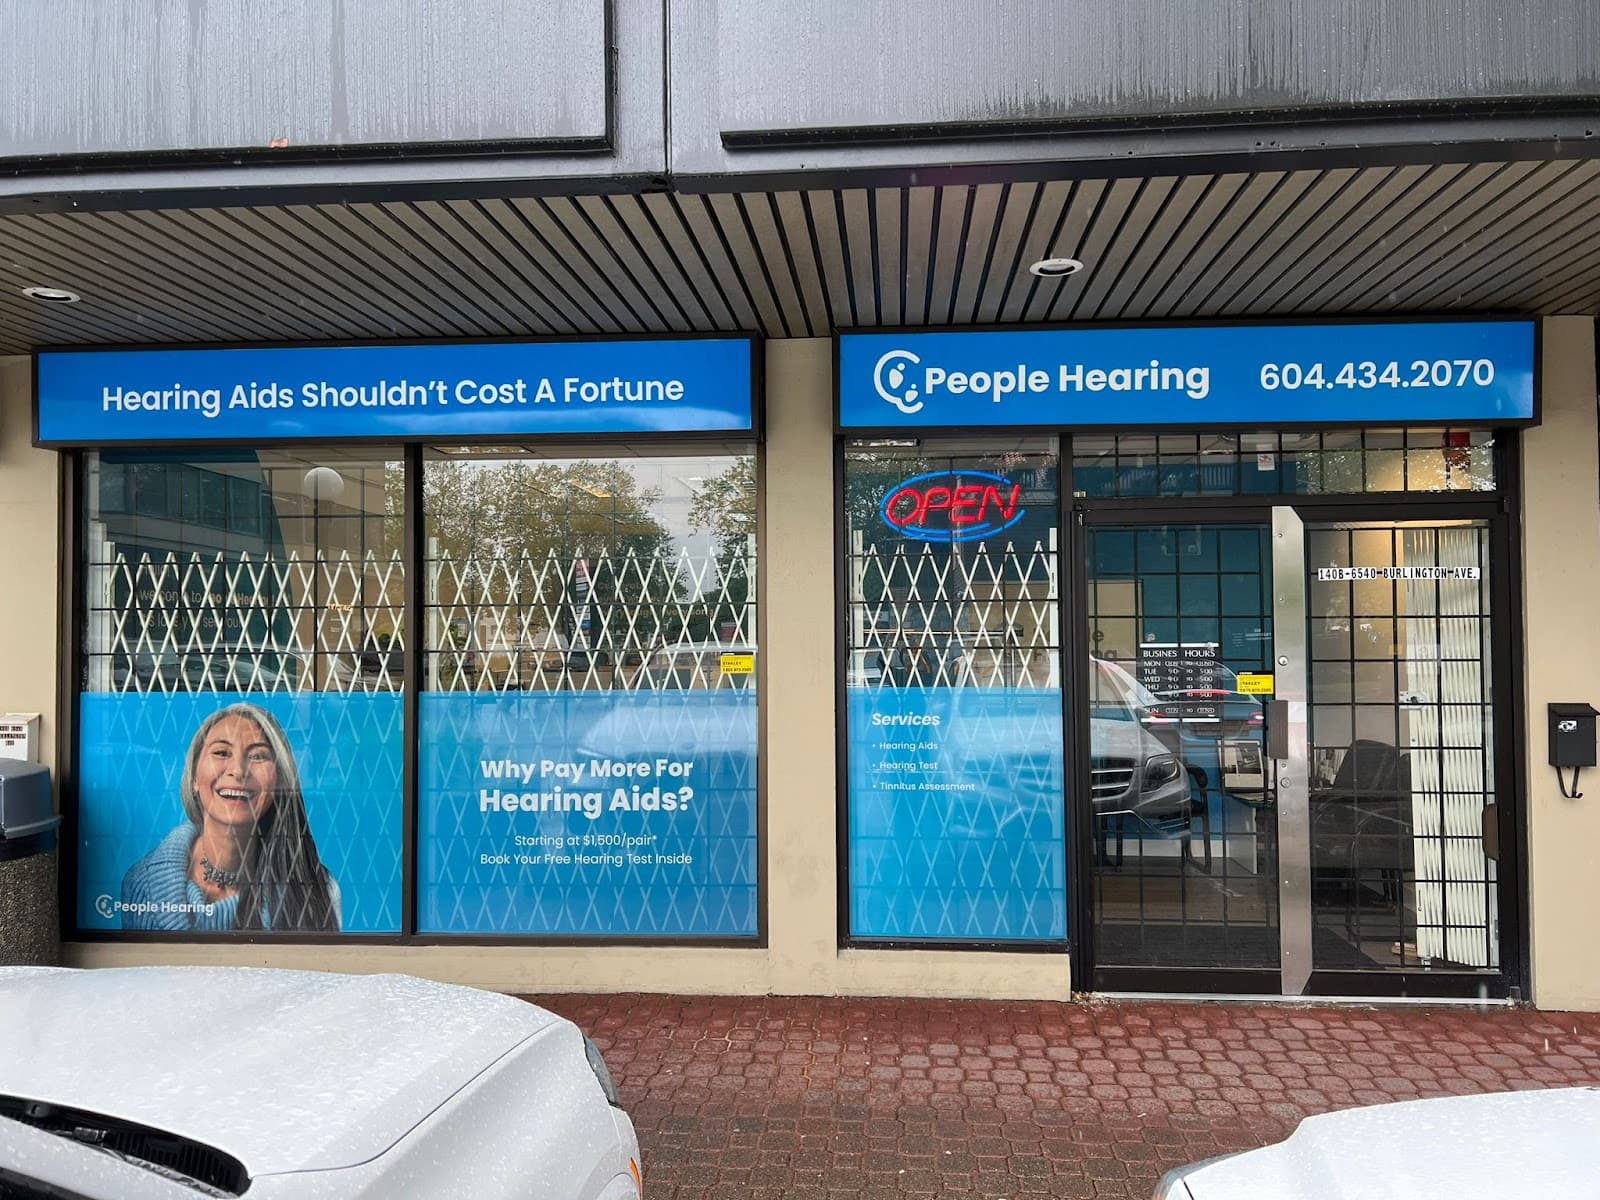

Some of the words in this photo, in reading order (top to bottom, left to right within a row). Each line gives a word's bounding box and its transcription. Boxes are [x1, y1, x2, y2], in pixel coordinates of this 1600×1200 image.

[925, 364, 1050, 402] People
[1059, 359, 1210, 400] Hearing
[1260, 358, 1495, 390] 604.434.2070
[103, 383, 220, 418] Hearing
[228, 382, 294, 409] Aids
[301, 380, 448, 408] Shouldn’t
[455, 379, 527, 405] Cost
[534, 378, 556, 403] A
[564, 377, 684, 403] Fortune
[886, 484, 1021, 525] OPEN
[1383, 567, 1447, 579] BURLINGTON
[1454, 567, 1478, 579] AVE.
[1184, 649, 1216, 657] HOURS
[871, 711, 941, 726] Services
[880, 741, 916, 752] Hearing
[918, 741, 939, 750] Aids
[480, 760, 536, 785] Why
[541, 759, 586, 784] Pay
[590, 759, 650, 777] More
[655, 759, 694, 777] For
[880, 761, 916, 772] Hearing
[919, 761, 938, 770] Test
[880, 782, 916, 791] Tinnitus
[918, 782, 976, 792] Assessment
[479, 785, 602, 820] Hearing
[608, 785, 694, 812] Aids?
[514, 834, 564, 849] Starting
[566, 835, 580, 846] at
[480, 853, 510, 865] Book
[513, 853, 541, 865] Your
[544, 854, 571, 865] Free
[574, 852, 624, 868] Hearing
[626, 853, 652, 865] Test
[655, 852, 693, 865] Inside
[114, 901, 159, 916] People
[161, 901, 214, 917] Hearing
